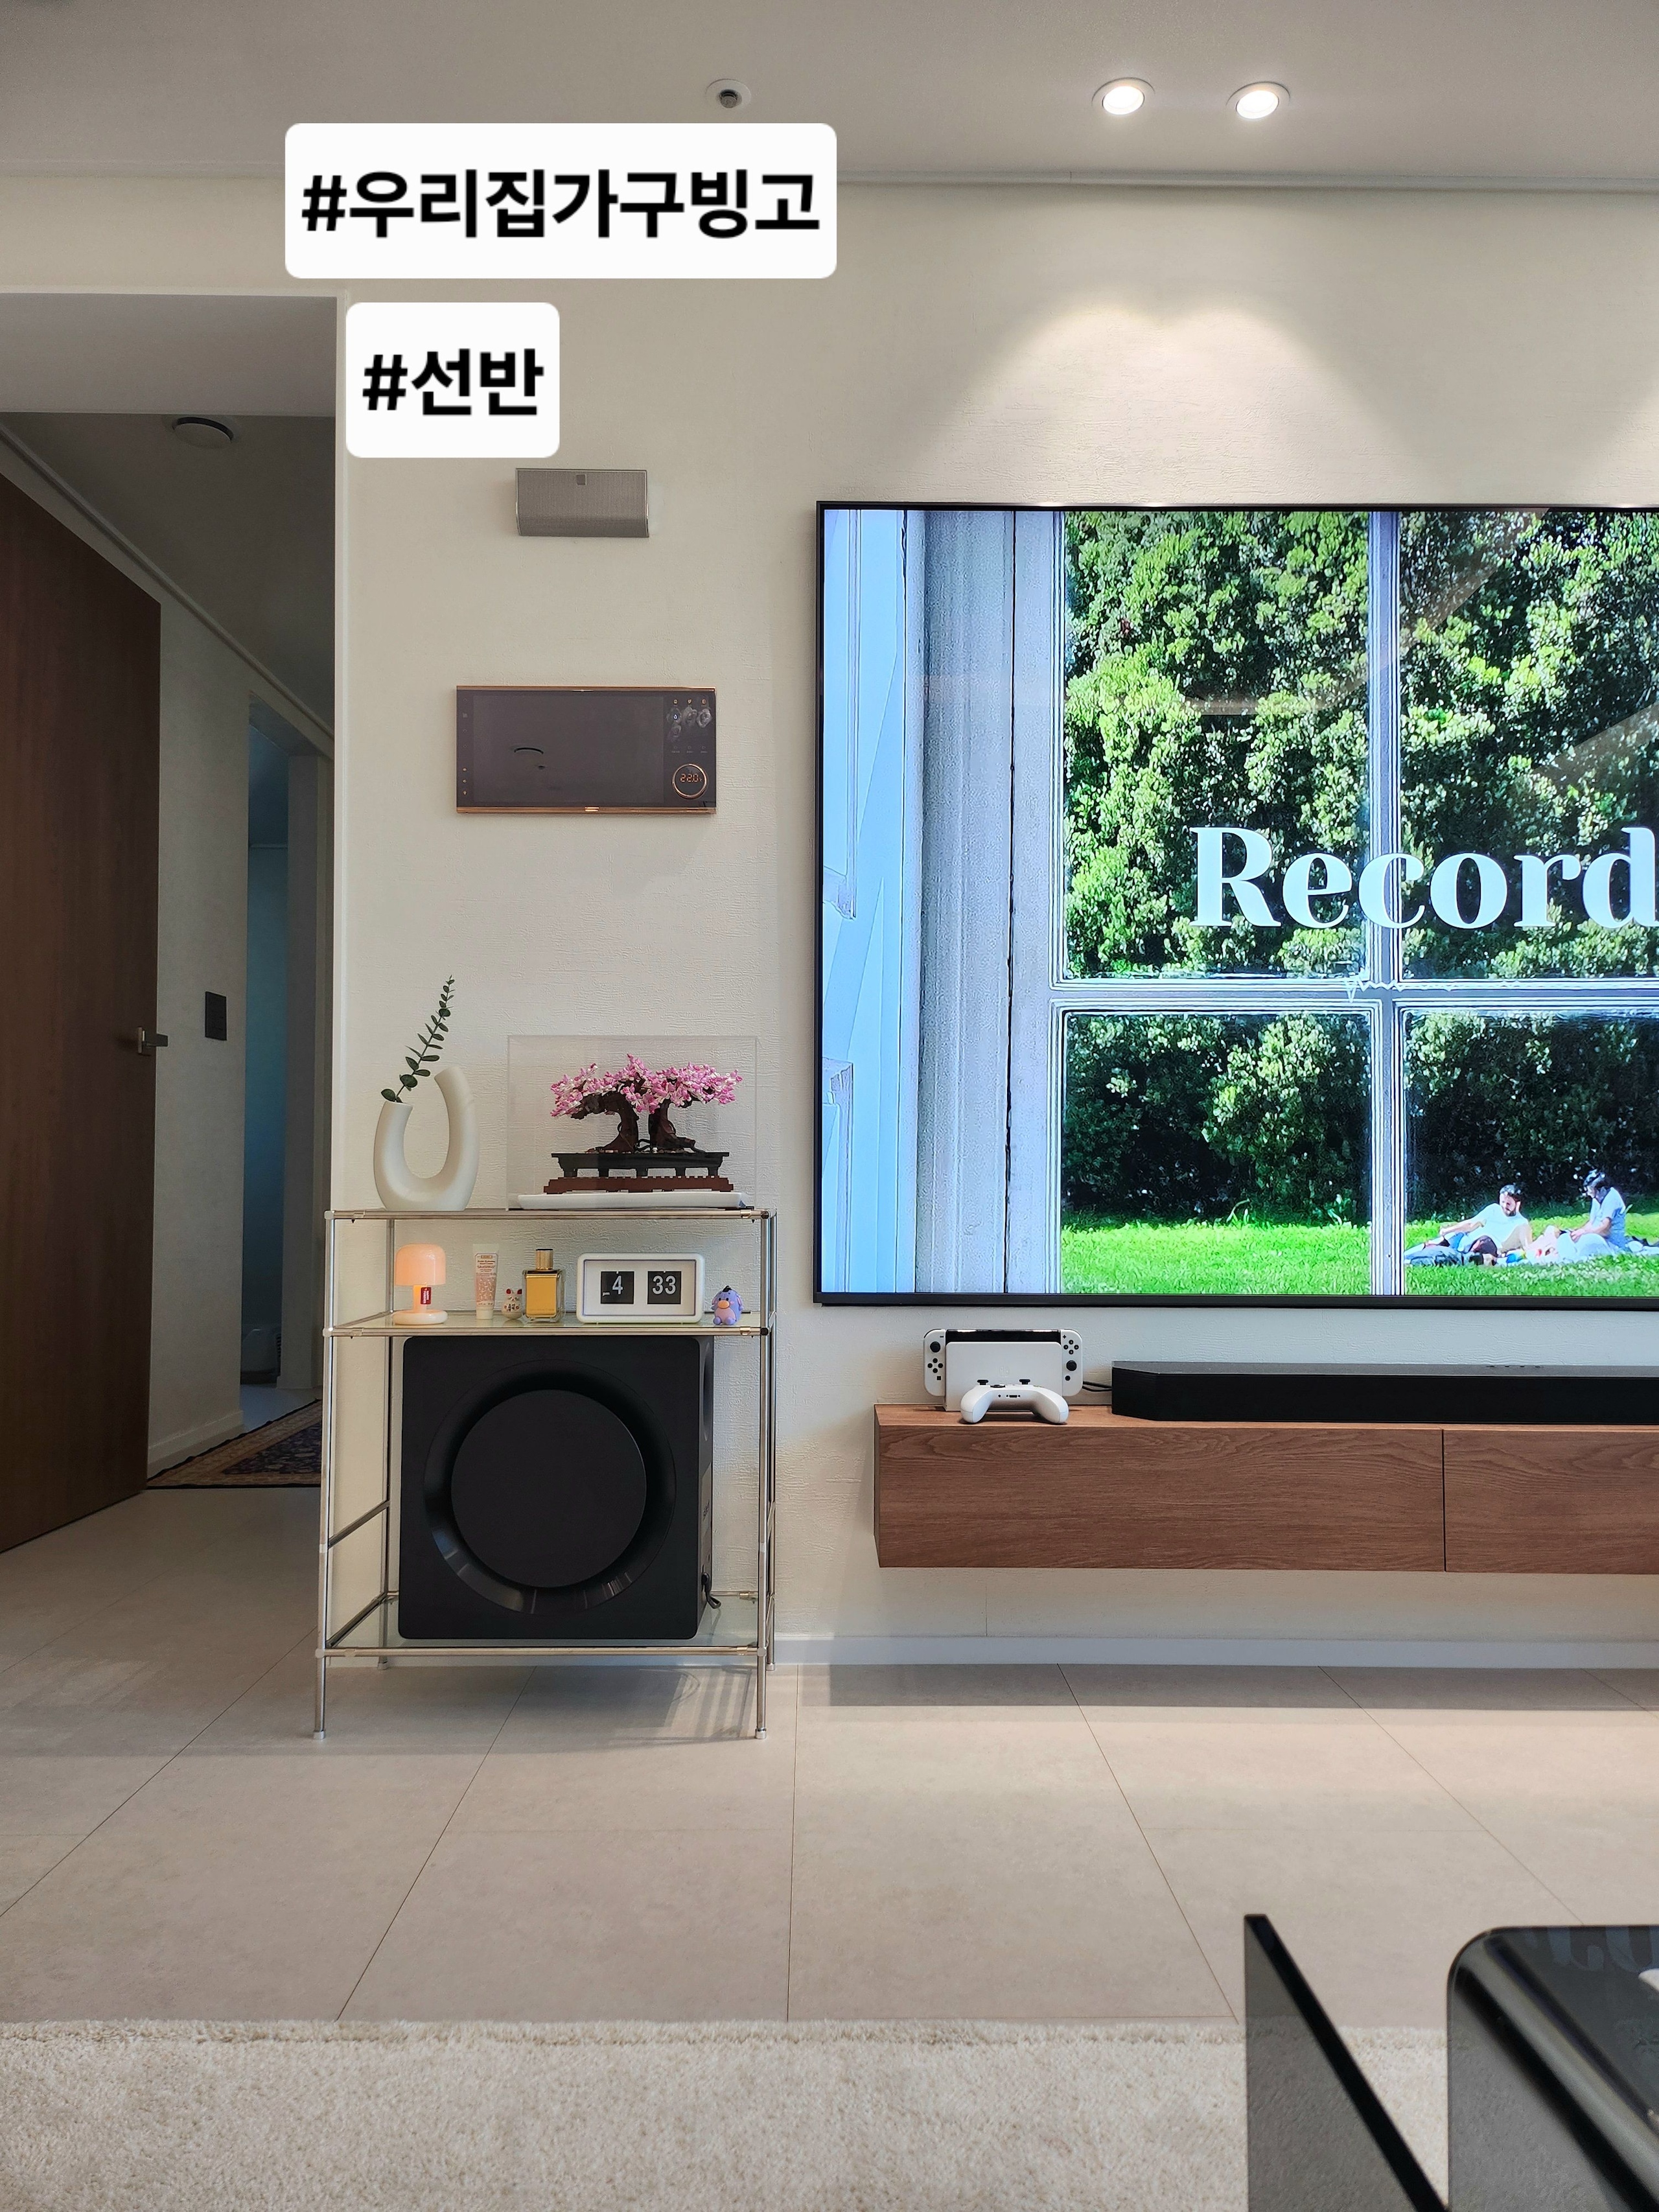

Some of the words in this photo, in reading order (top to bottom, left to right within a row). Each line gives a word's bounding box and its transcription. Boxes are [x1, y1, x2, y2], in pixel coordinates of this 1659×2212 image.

[1189, 827, 1659, 929] Record
[612, 1275, 623, 1295] 4
[652, 1275, 676, 1295] 33
